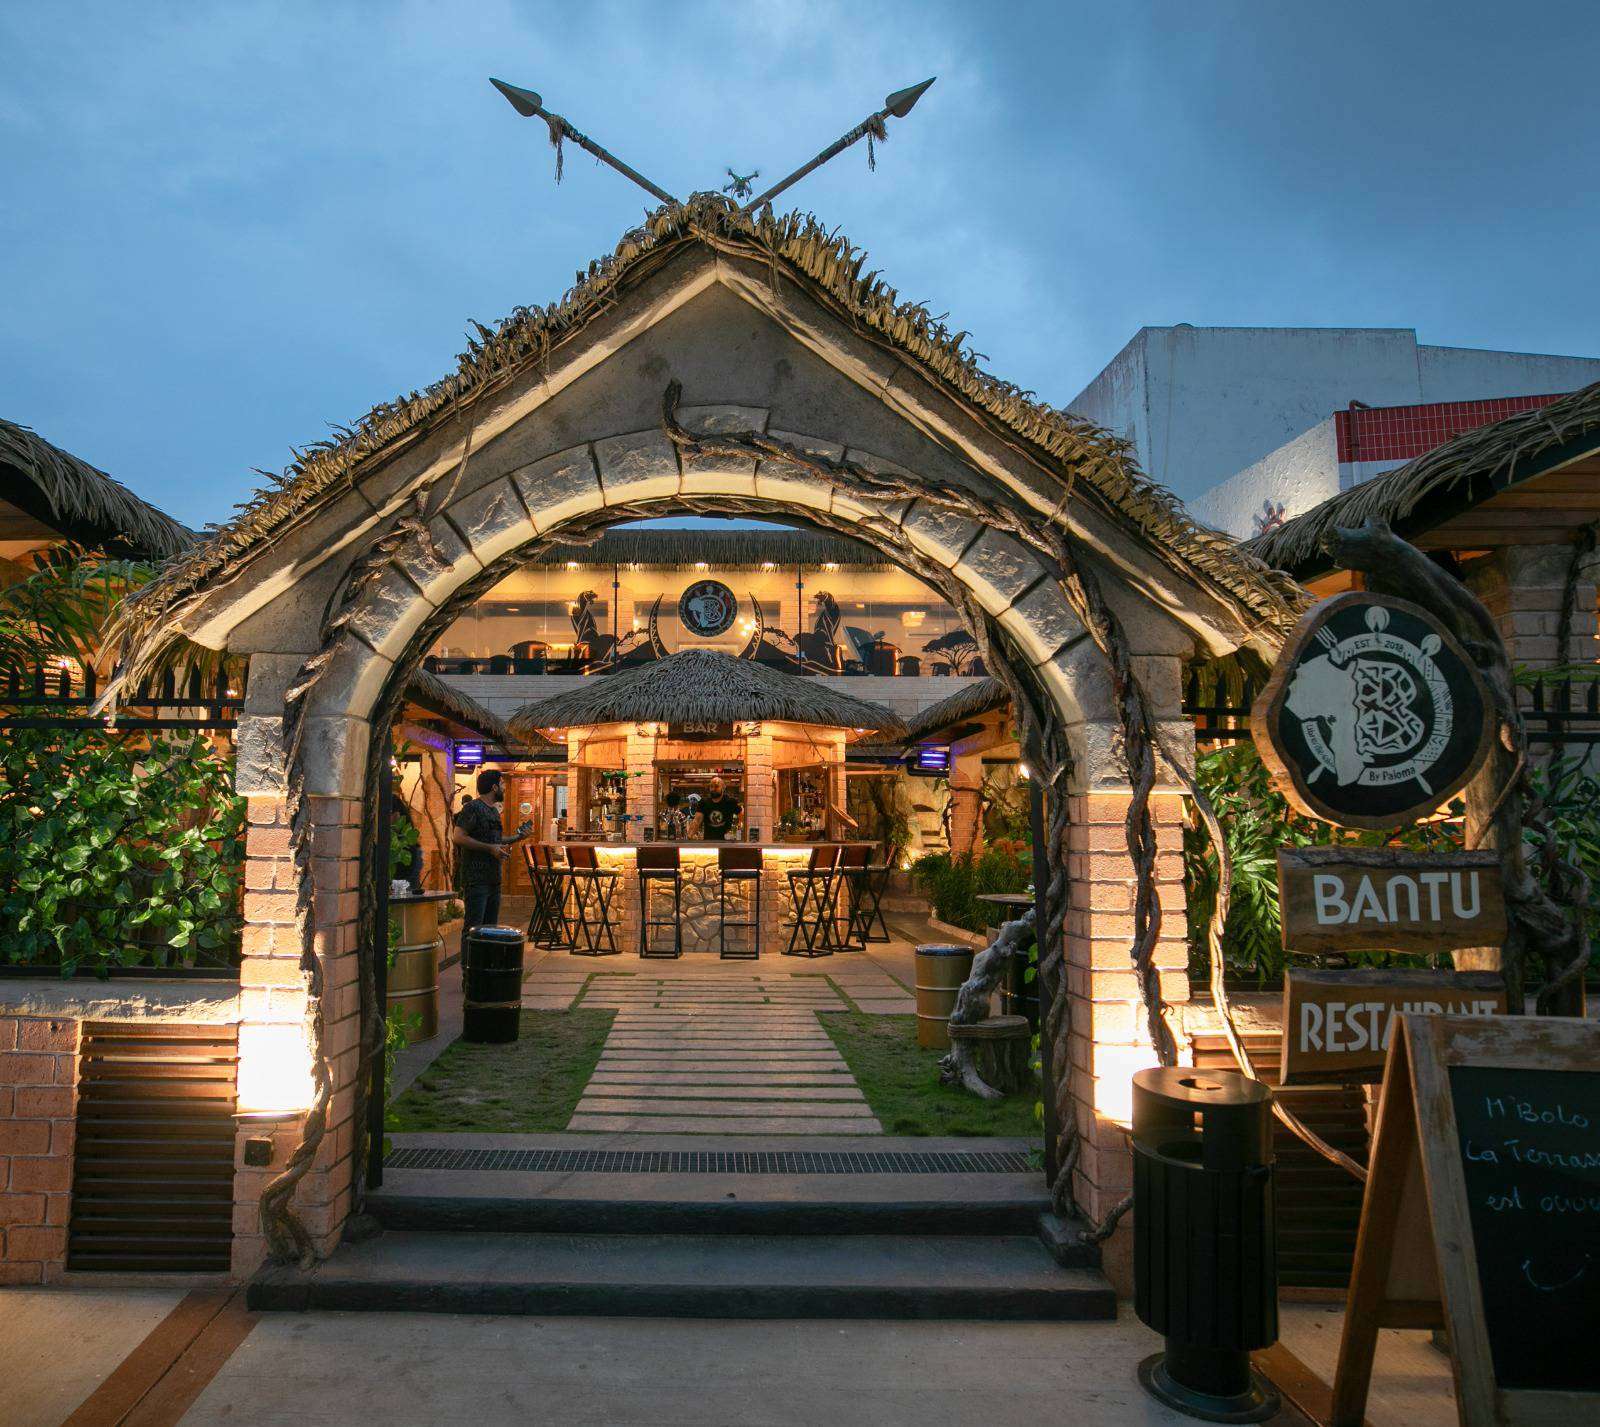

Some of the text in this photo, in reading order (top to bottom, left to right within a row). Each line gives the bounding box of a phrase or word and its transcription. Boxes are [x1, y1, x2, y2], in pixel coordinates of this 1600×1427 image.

[1354, 639, 1369, 650] EST
[683, 722, 718, 733] BAR
[1368, 766, 1416, 782] By Paloma
[1313, 871, 1481, 924] BANTU
[1466, 1140, 1499, 1163] La
[1486, 1186, 1524, 1211] est
